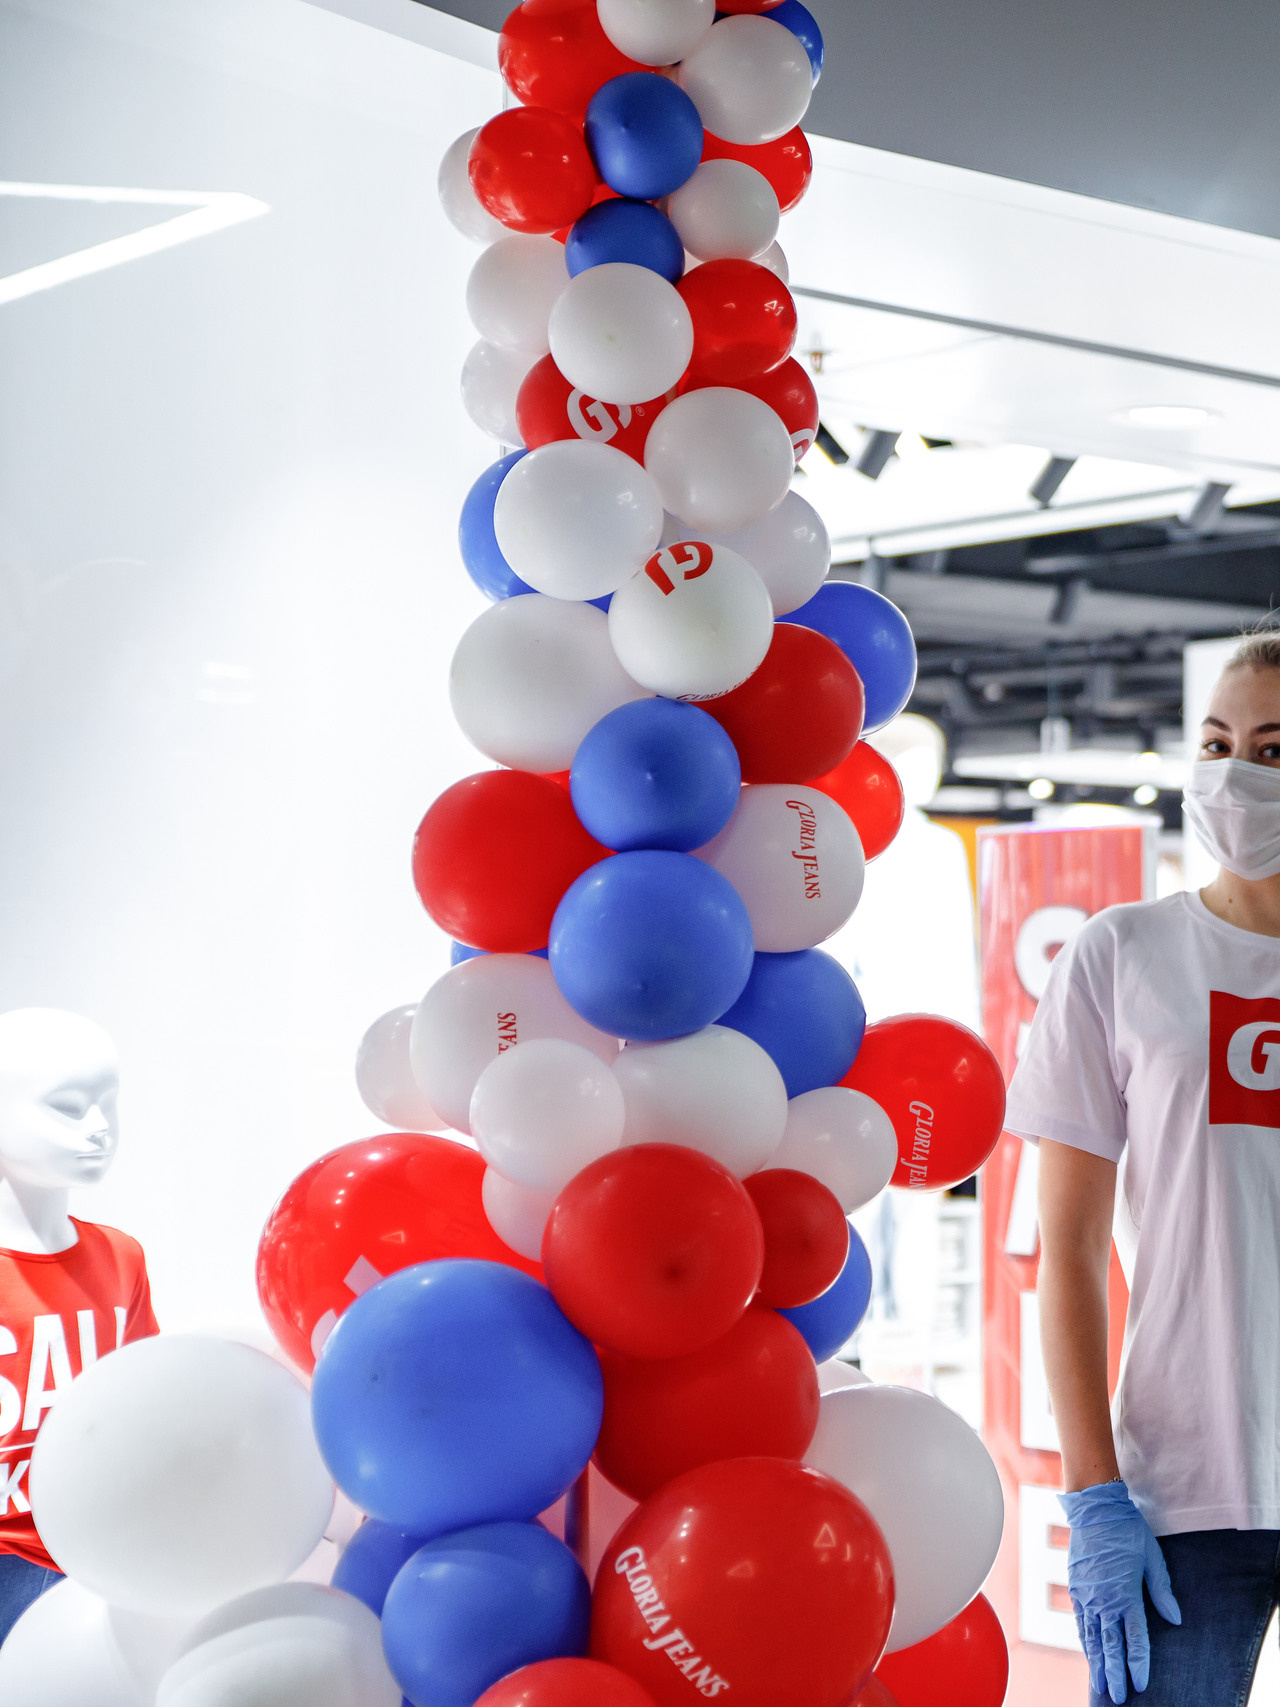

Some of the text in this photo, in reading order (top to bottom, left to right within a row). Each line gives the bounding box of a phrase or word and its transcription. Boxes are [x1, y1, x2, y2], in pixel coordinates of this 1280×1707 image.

[645, 541, 713, 596] GJ
[785, 800, 821, 899] GLORIA JEANS
[901, 1100, 934, 1190] GLORIA JEAN
[615, 1546, 730, 1697] GLORIA JEANS
